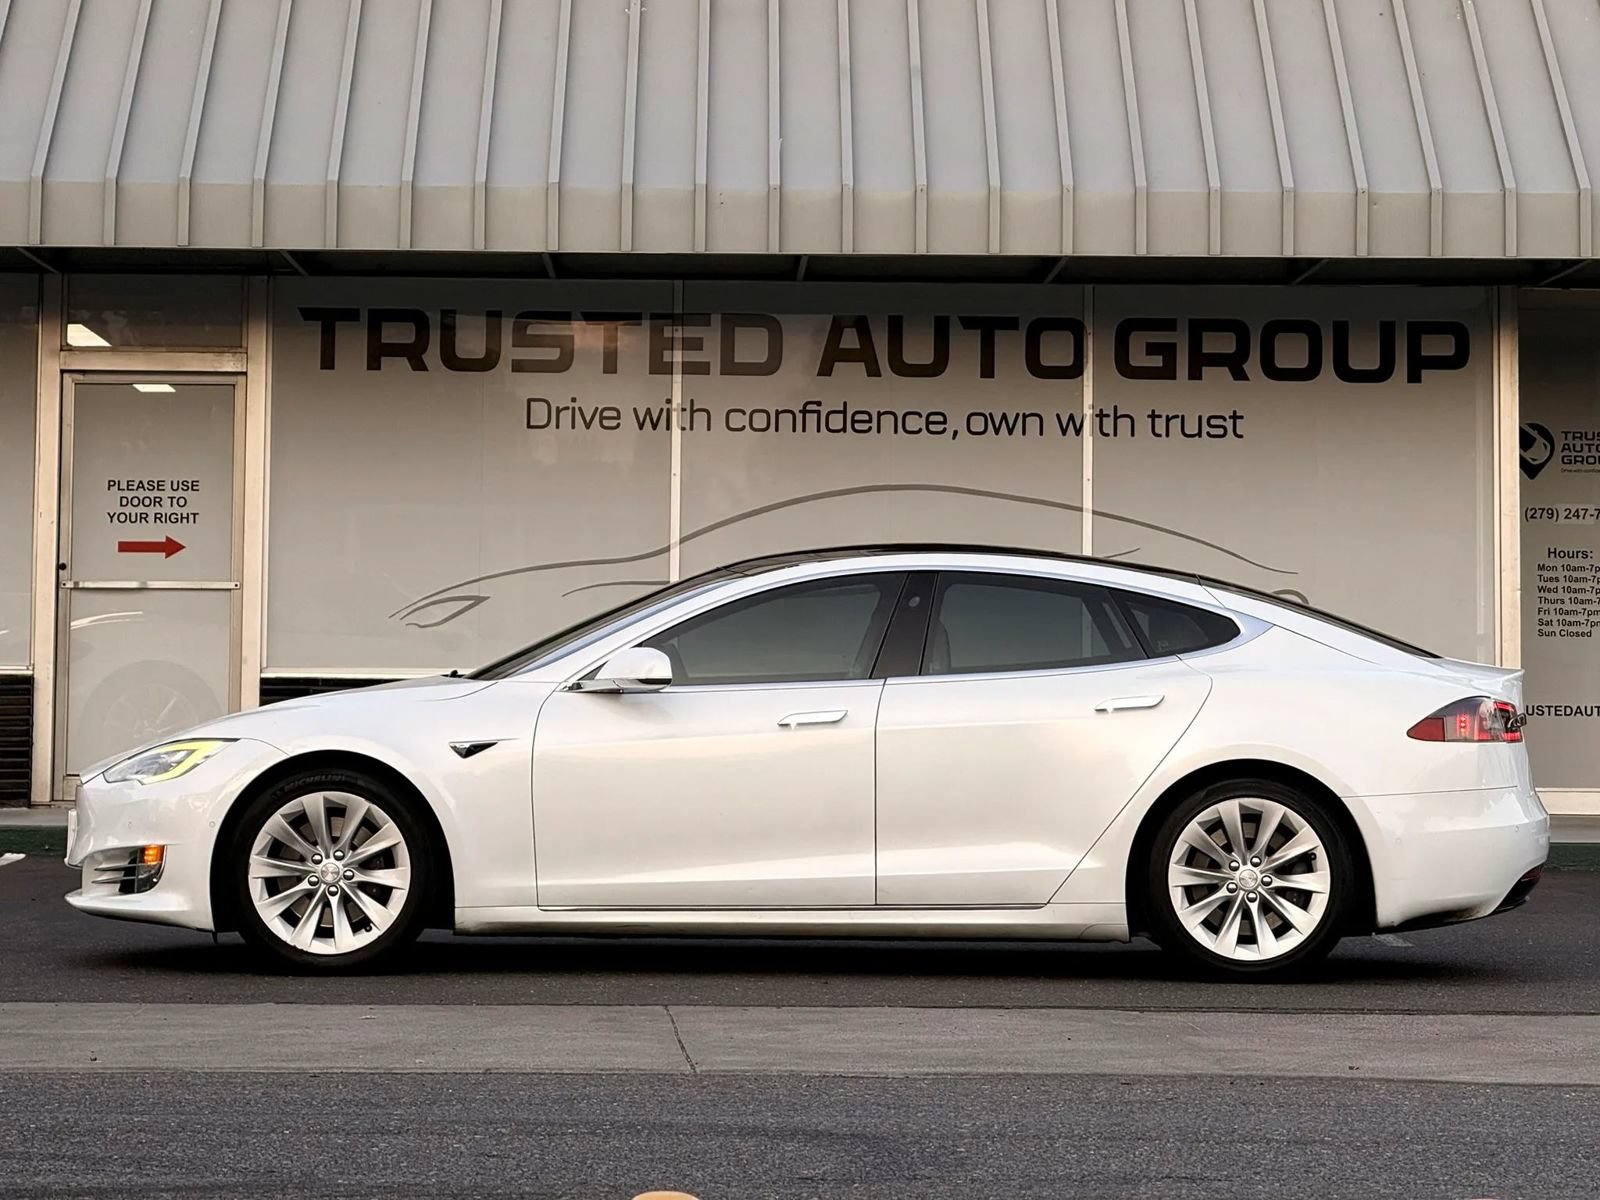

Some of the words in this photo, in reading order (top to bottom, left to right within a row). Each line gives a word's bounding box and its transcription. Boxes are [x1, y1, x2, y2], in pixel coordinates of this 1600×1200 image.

[296, 306, 784, 377] TRUSTED
[816, 314, 1088, 380] AUTO
[1114, 317, 1471, 384] GROUP
[526, 397, 621, 431] Drive
[632, 398, 712, 432] with
[965, 411, 1044, 437] own
[1055, 404, 1136, 438] with
[1146, 408, 1245, 439] trust
[1561, 454, 1600, 466] GRO
[107, 479, 166, 492] PLEASE
[170, 479, 200, 492] USE
[119, 495, 163, 508] DOOR
[167, 495, 188, 508] TO
[106, 511, 149, 524] YOUR
[153, 511, 200, 524] RIGHT
[1524, 506, 1560, 523] (279)
[1563, 507, 1600, 521] 247-7
[1547, 546, 1594, 560] Hours:
[1537, 563, 1558, 572] Mon
[1537, 574, 1561, 583] Tues
[1537, 585, 1559, 594] Wed
[1537, 596, 1566, 605] Thurs
[1537, 607, 1551, 616] Fri
[1537, 617, 1554, 627] Sat
[1537, 628, 1557, 638] Sun
[1559, 628, 1593, 638] Closed
[1525, 704, 1600, 717] USTEDAUT
